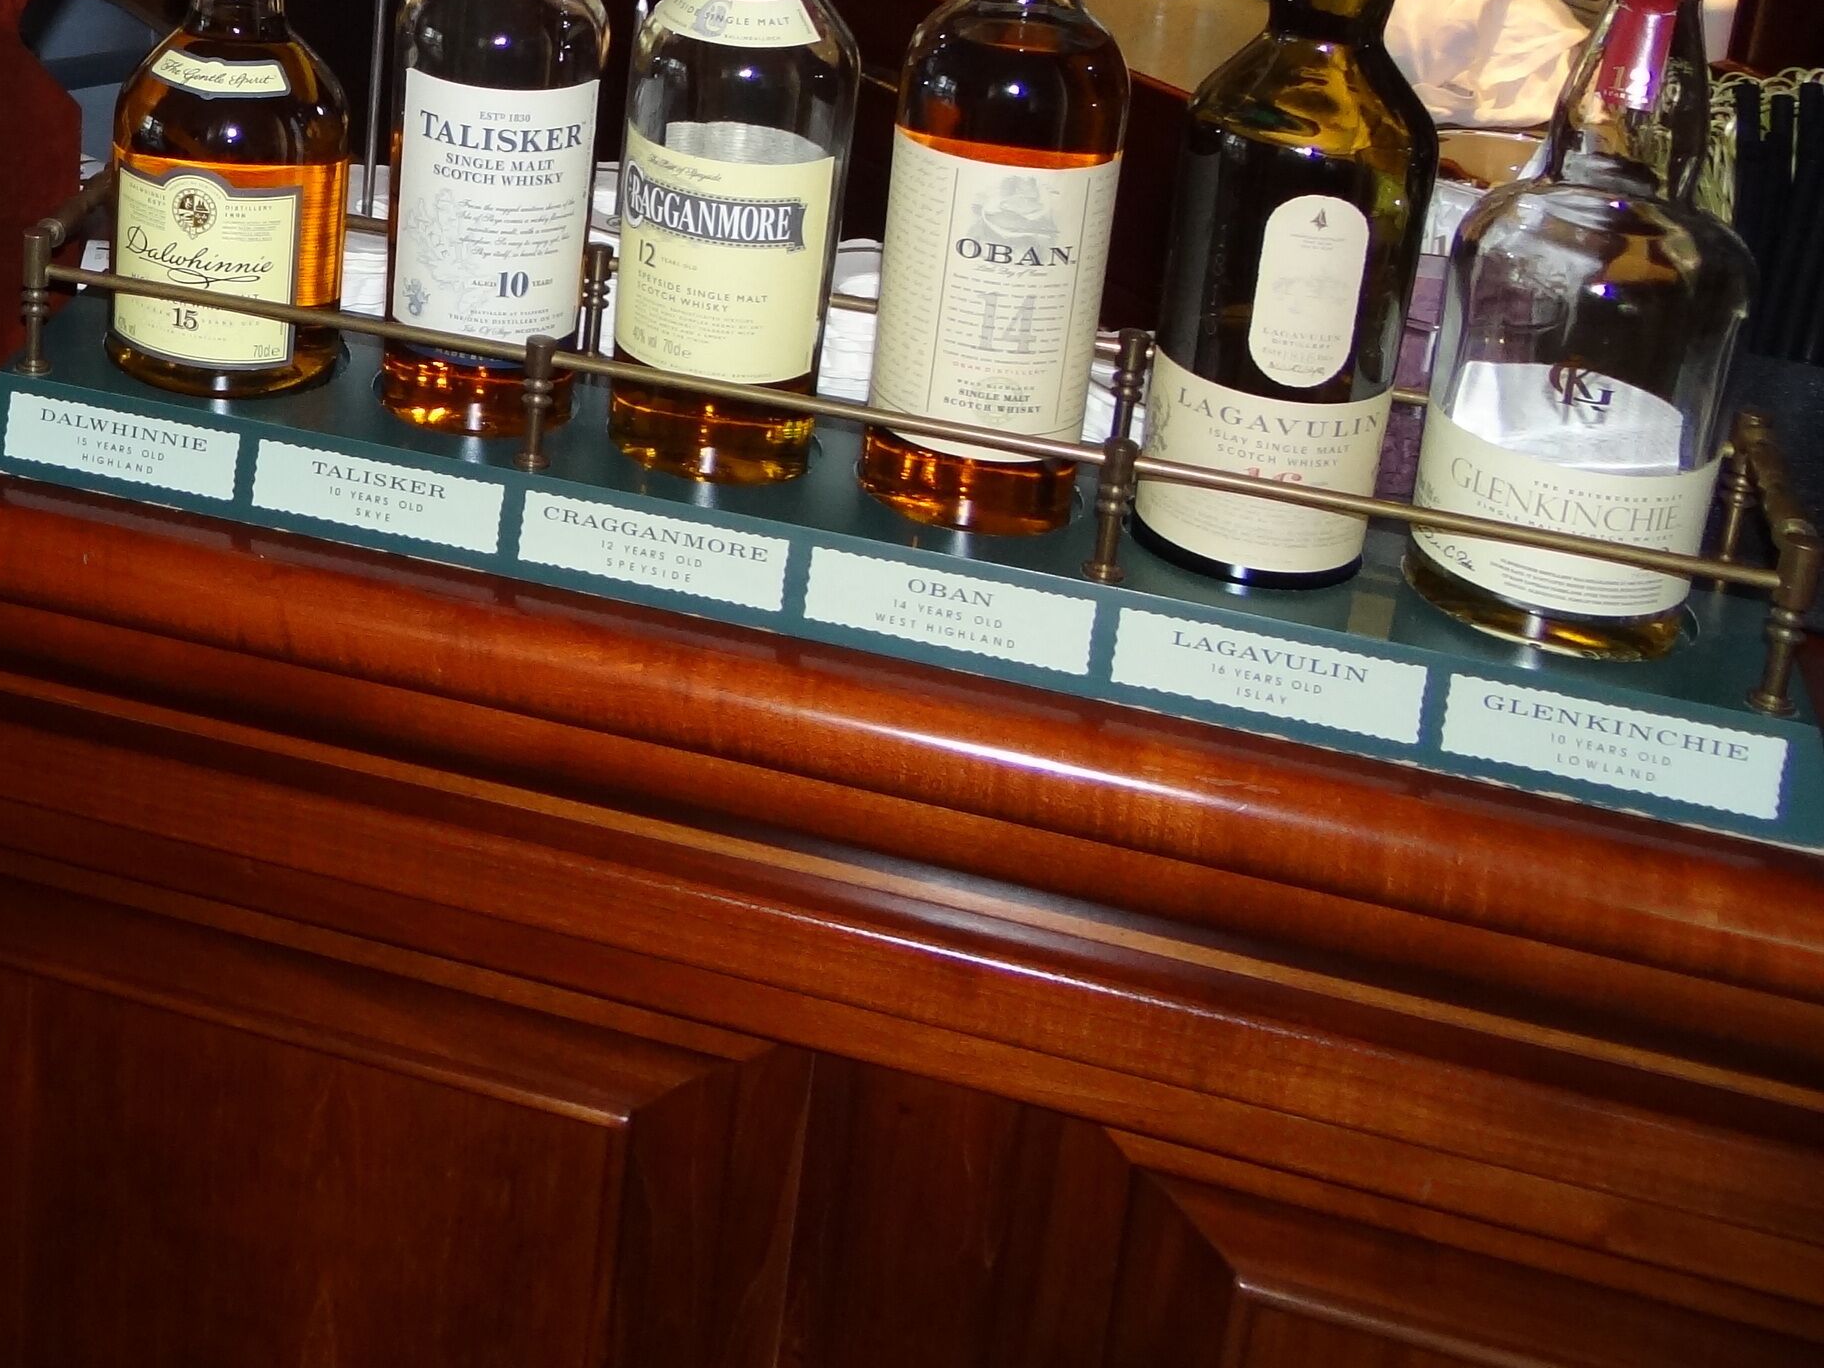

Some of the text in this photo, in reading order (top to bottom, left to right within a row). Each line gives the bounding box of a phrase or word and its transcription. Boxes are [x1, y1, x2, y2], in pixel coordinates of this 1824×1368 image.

[704, 10, 750, 27] SINGLE
[757, 15, 791, 27] MALT
[161, 58, 276, 88] The Gentle Spirit
[419, 109, 584, 153] TALISKER
[509, 112, 532, 123] 1830
[432, 163, 564, 187] SCOTCH WHISKY
[445, 152, 556, 172] SINGLE MALT
[625, 160, 792, 241] CRAGGANMORE
[125, 225, 274, 274] Dalwhinnie
[638, 239, 656, 268] 12
[955, 237, 1074, 267] OBAN
[495, 271, 530, 299] 10
[637, 270, 769, 304] SPEYSIDE SINGLE MALT
[637, 281, 729, 313] SCOTCH WHISKY
[171, 307, 200, 332] 15
[977, 291, 1037, 354] 14
[943, 396, 1042, 414] SCOTCH WHISKY
[958, 387, 1030, 403] SINGLE MALT
[1177, 387, 1380, 439] LAGAVULIN
[40, 408, 208, 452] DALWHINNIE
[1208, 427, 1351, 455] ISLAY SINGLE MALT
[76, 436, 165, 461] 15 YEARS OLD
[1216, 443, 1339, 469] SCOTCH WHISKY
[82, 453, 154, 474] HIGHLAND
[312, 461, 446, 499] TALISKER
[1450, 457, 1681, 532] GLENKINCHIE
[329, 486, 424, 513] 10 YEARS OLD
[1477, 500, 1519, 521] SINGLE
[355, 507, 391, 522] SKYE
[543, 506, 768, 562] CRAGGANMORE
[601, 539, 703, 568] 12 YEARS OLD
[606, 557, 692, 583] SPEYSIDE
[908, 578, 995, 607] OBAN
[893, 599, 1003, 629] 14 YEARS OLD
[875, 612, 1016, 649] WEST HIGHLAND
[1172, 630, 1369, 683] LAGAVULIN
[1211, 663, 1323, 694] 16 YEARS OLD
[1236, 686, 1289, 705] ISLAY
[1483, 694, 1750, 762] GLENKINCHIE
[1550, 732, 1672, 767] 10 YEARS OLD
[1556, 753, 1657, 782] LOWLAND
